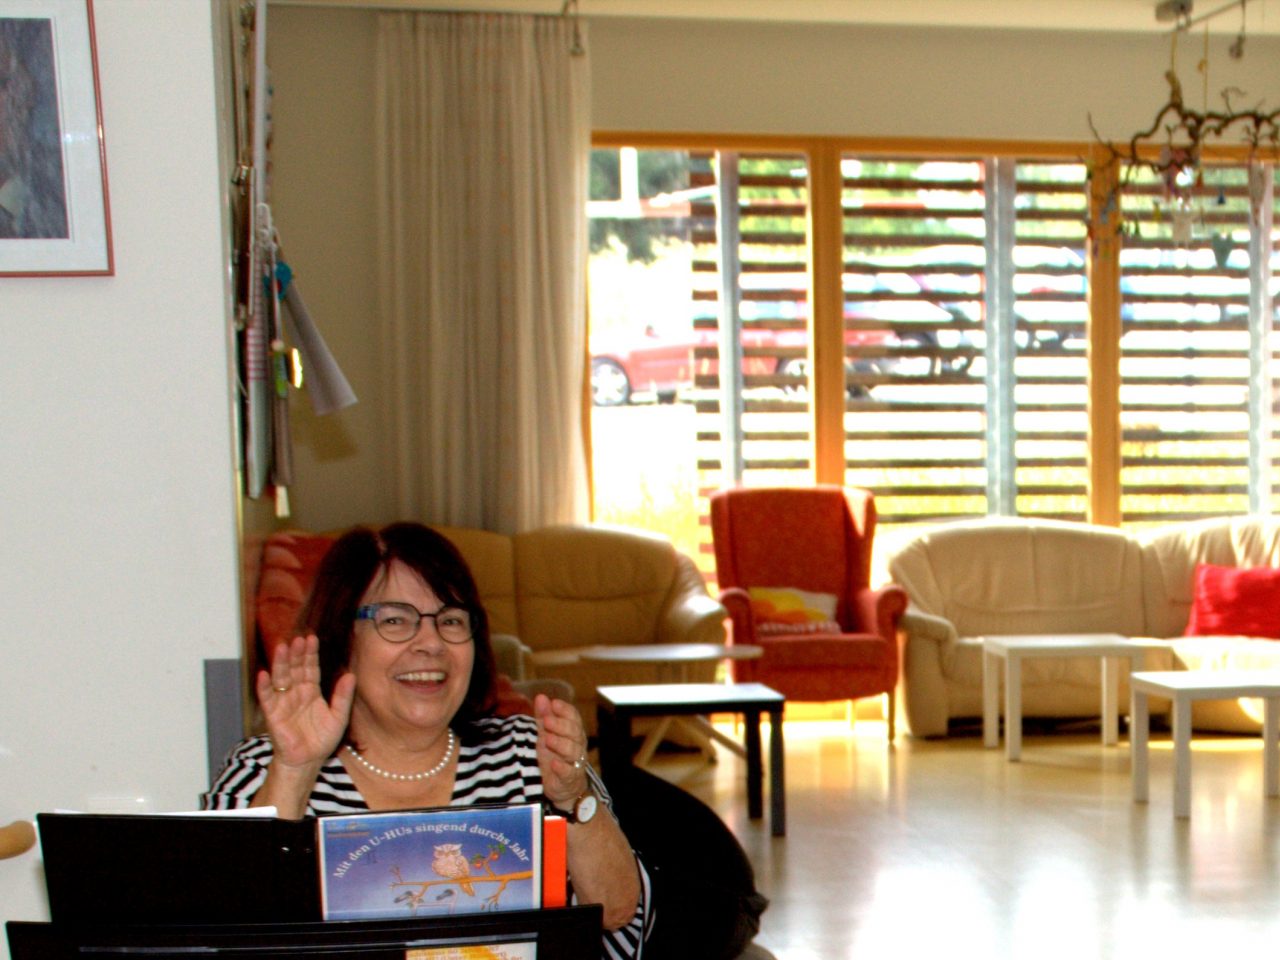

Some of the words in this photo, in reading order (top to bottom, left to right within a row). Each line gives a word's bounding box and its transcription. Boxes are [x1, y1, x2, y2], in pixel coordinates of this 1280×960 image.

[332, 860, 352, 879] Mit
[348, 844, 371, 861] den
[416, 823, 467, 834] singend
[469, 824, 511, 846] durchs
[509, 842, 530, 862] Jahr
